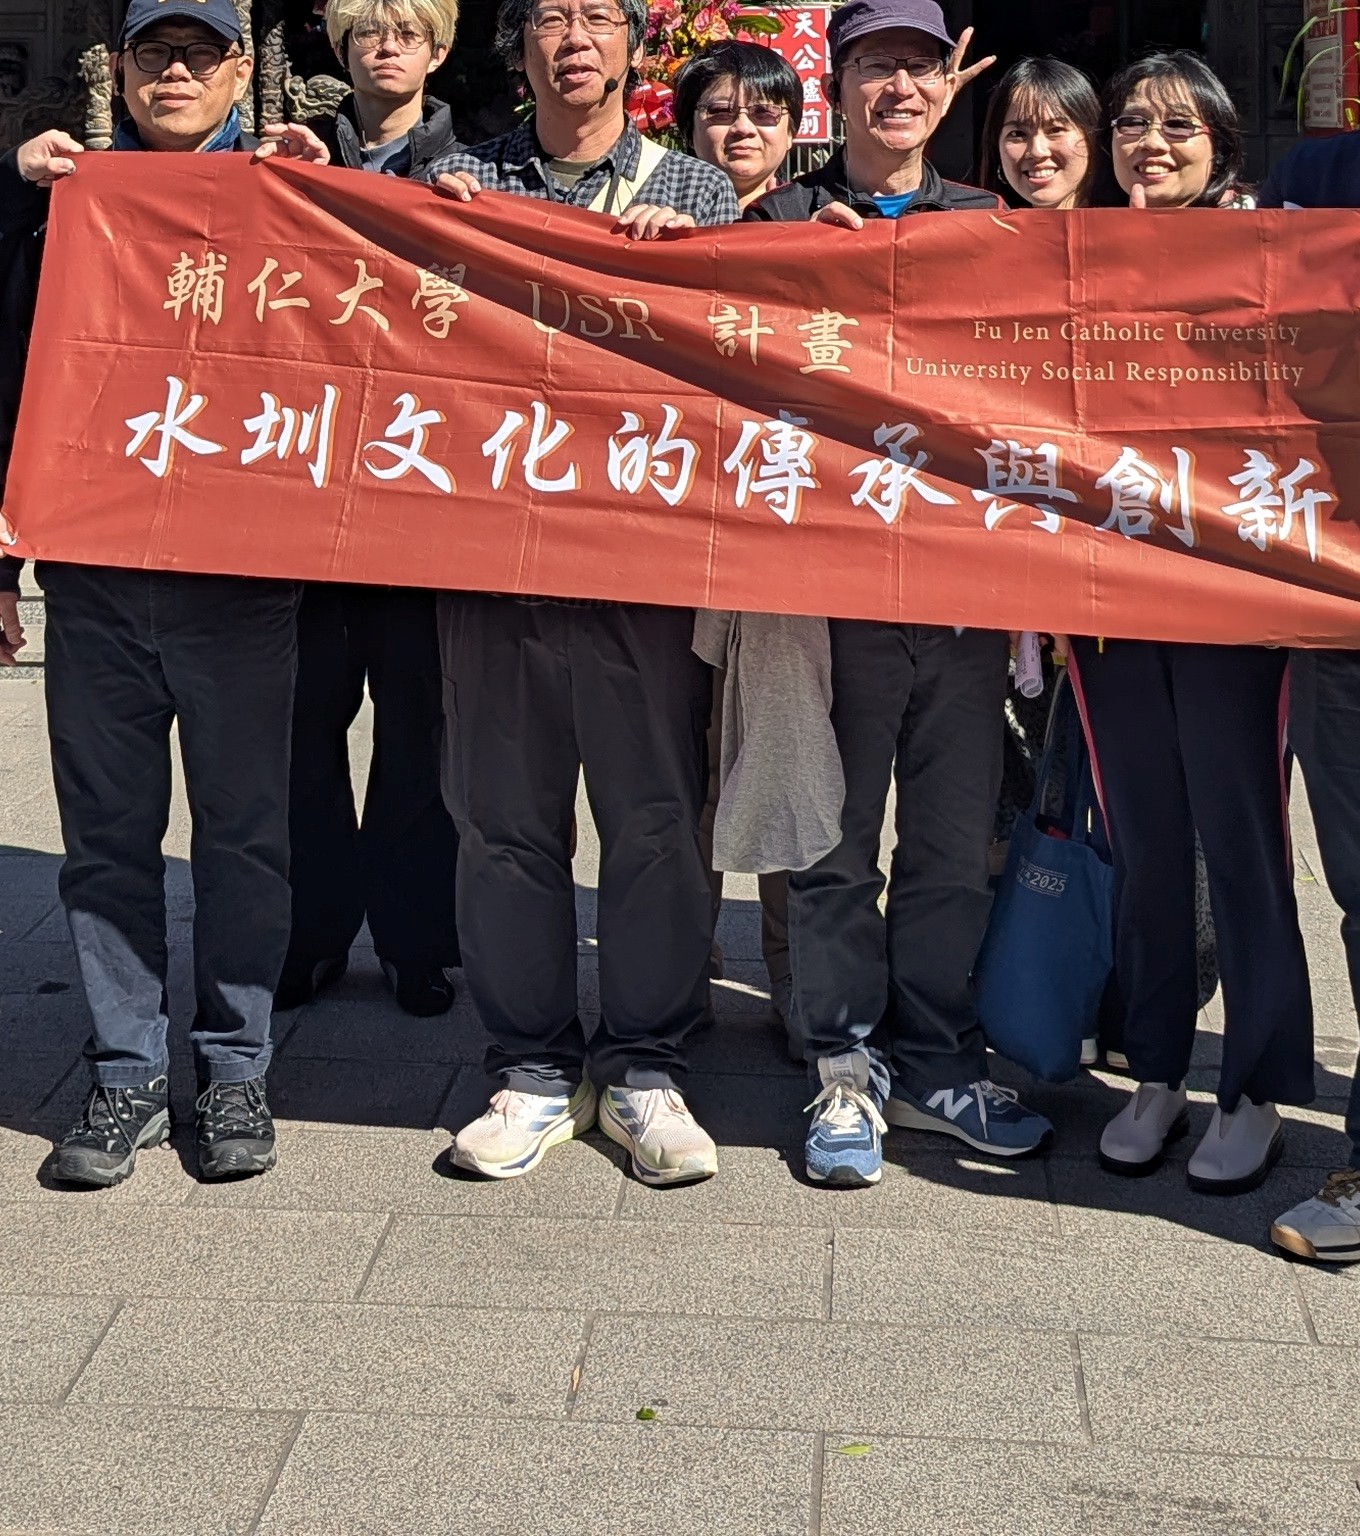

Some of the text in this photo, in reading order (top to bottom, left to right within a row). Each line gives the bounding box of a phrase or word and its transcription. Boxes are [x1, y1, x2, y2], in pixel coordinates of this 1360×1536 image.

[163, 252, 860, 376] 輔仁大學 USR 計畫
[973, 319, 1300, 346] Fu Jen Catholic University
[906, 357, 1304, 386] University Social Responsibility
[125, 375, 1338, 563] 水圳文化的傳承與創新
[1029, 872, 1066, 893] 2025
